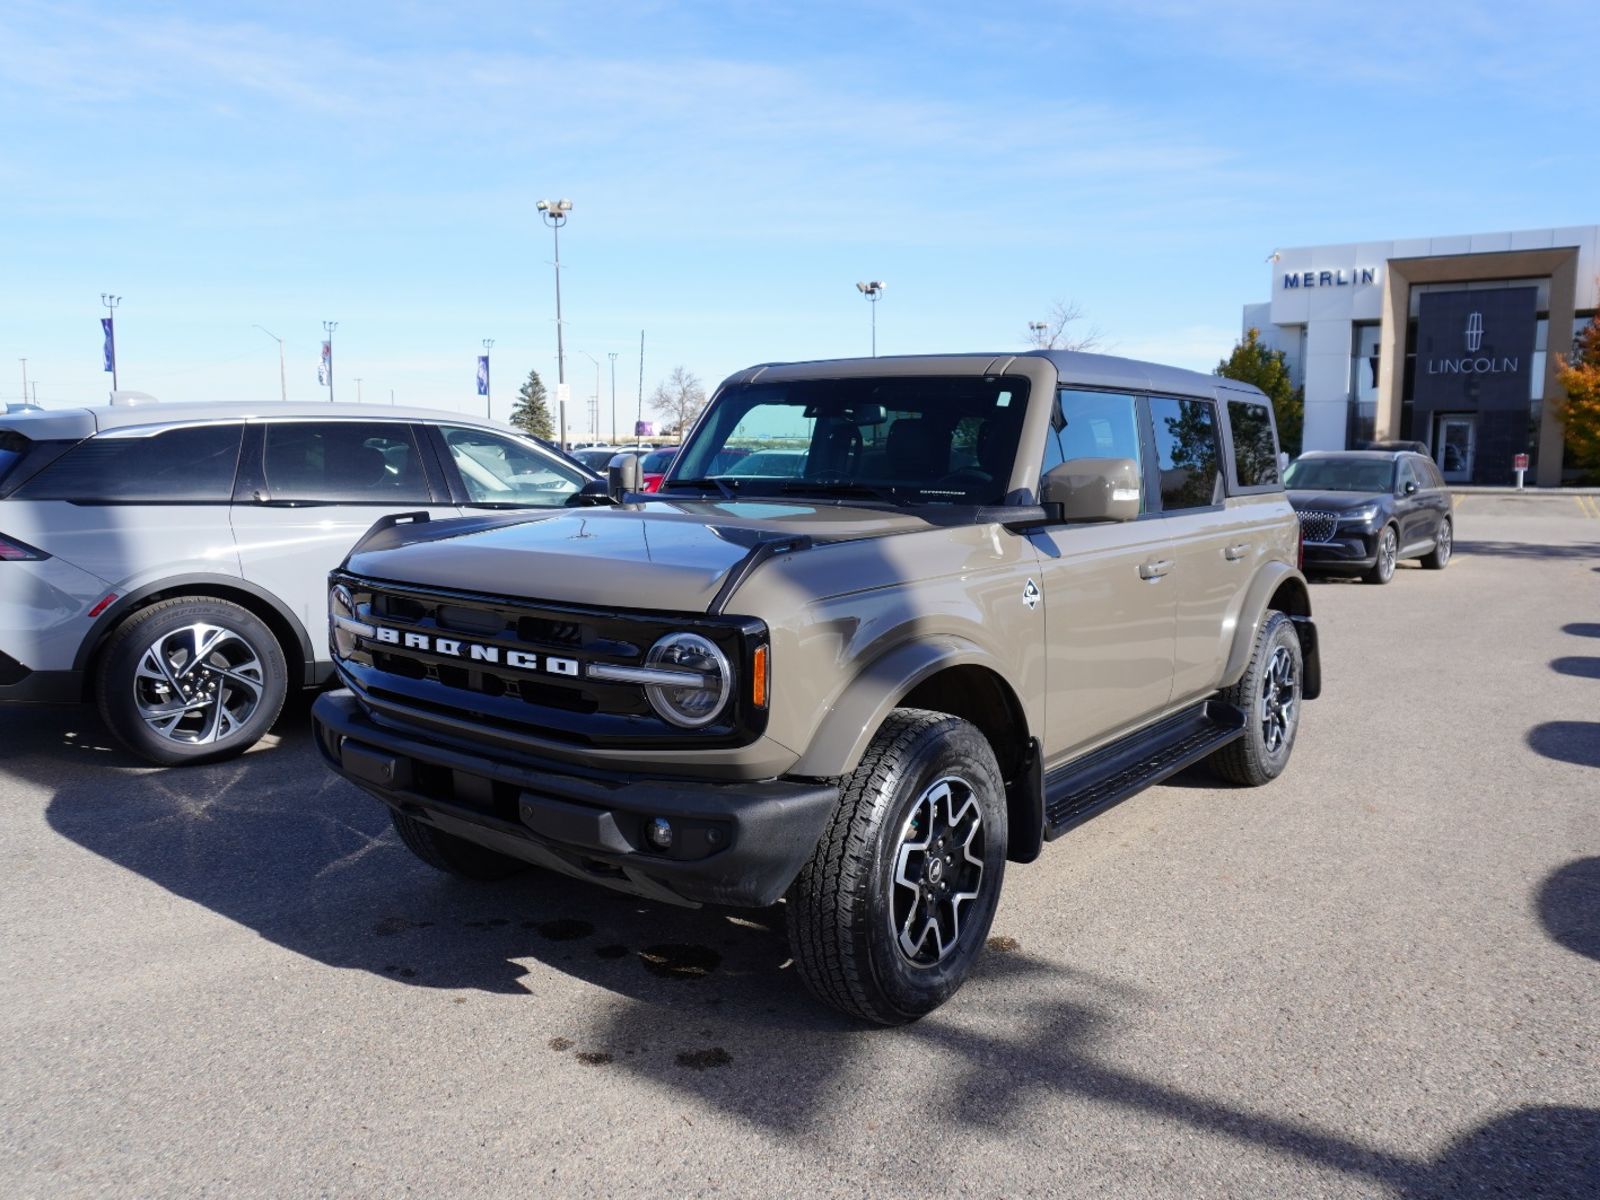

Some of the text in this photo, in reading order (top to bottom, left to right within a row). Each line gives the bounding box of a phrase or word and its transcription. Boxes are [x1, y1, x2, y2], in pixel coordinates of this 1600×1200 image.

[1284, 267, 1375, 289] MERLIN
[1428, 357, 1518, 374] LINCOLN
[376, 626, 579, 676] BRONCO
